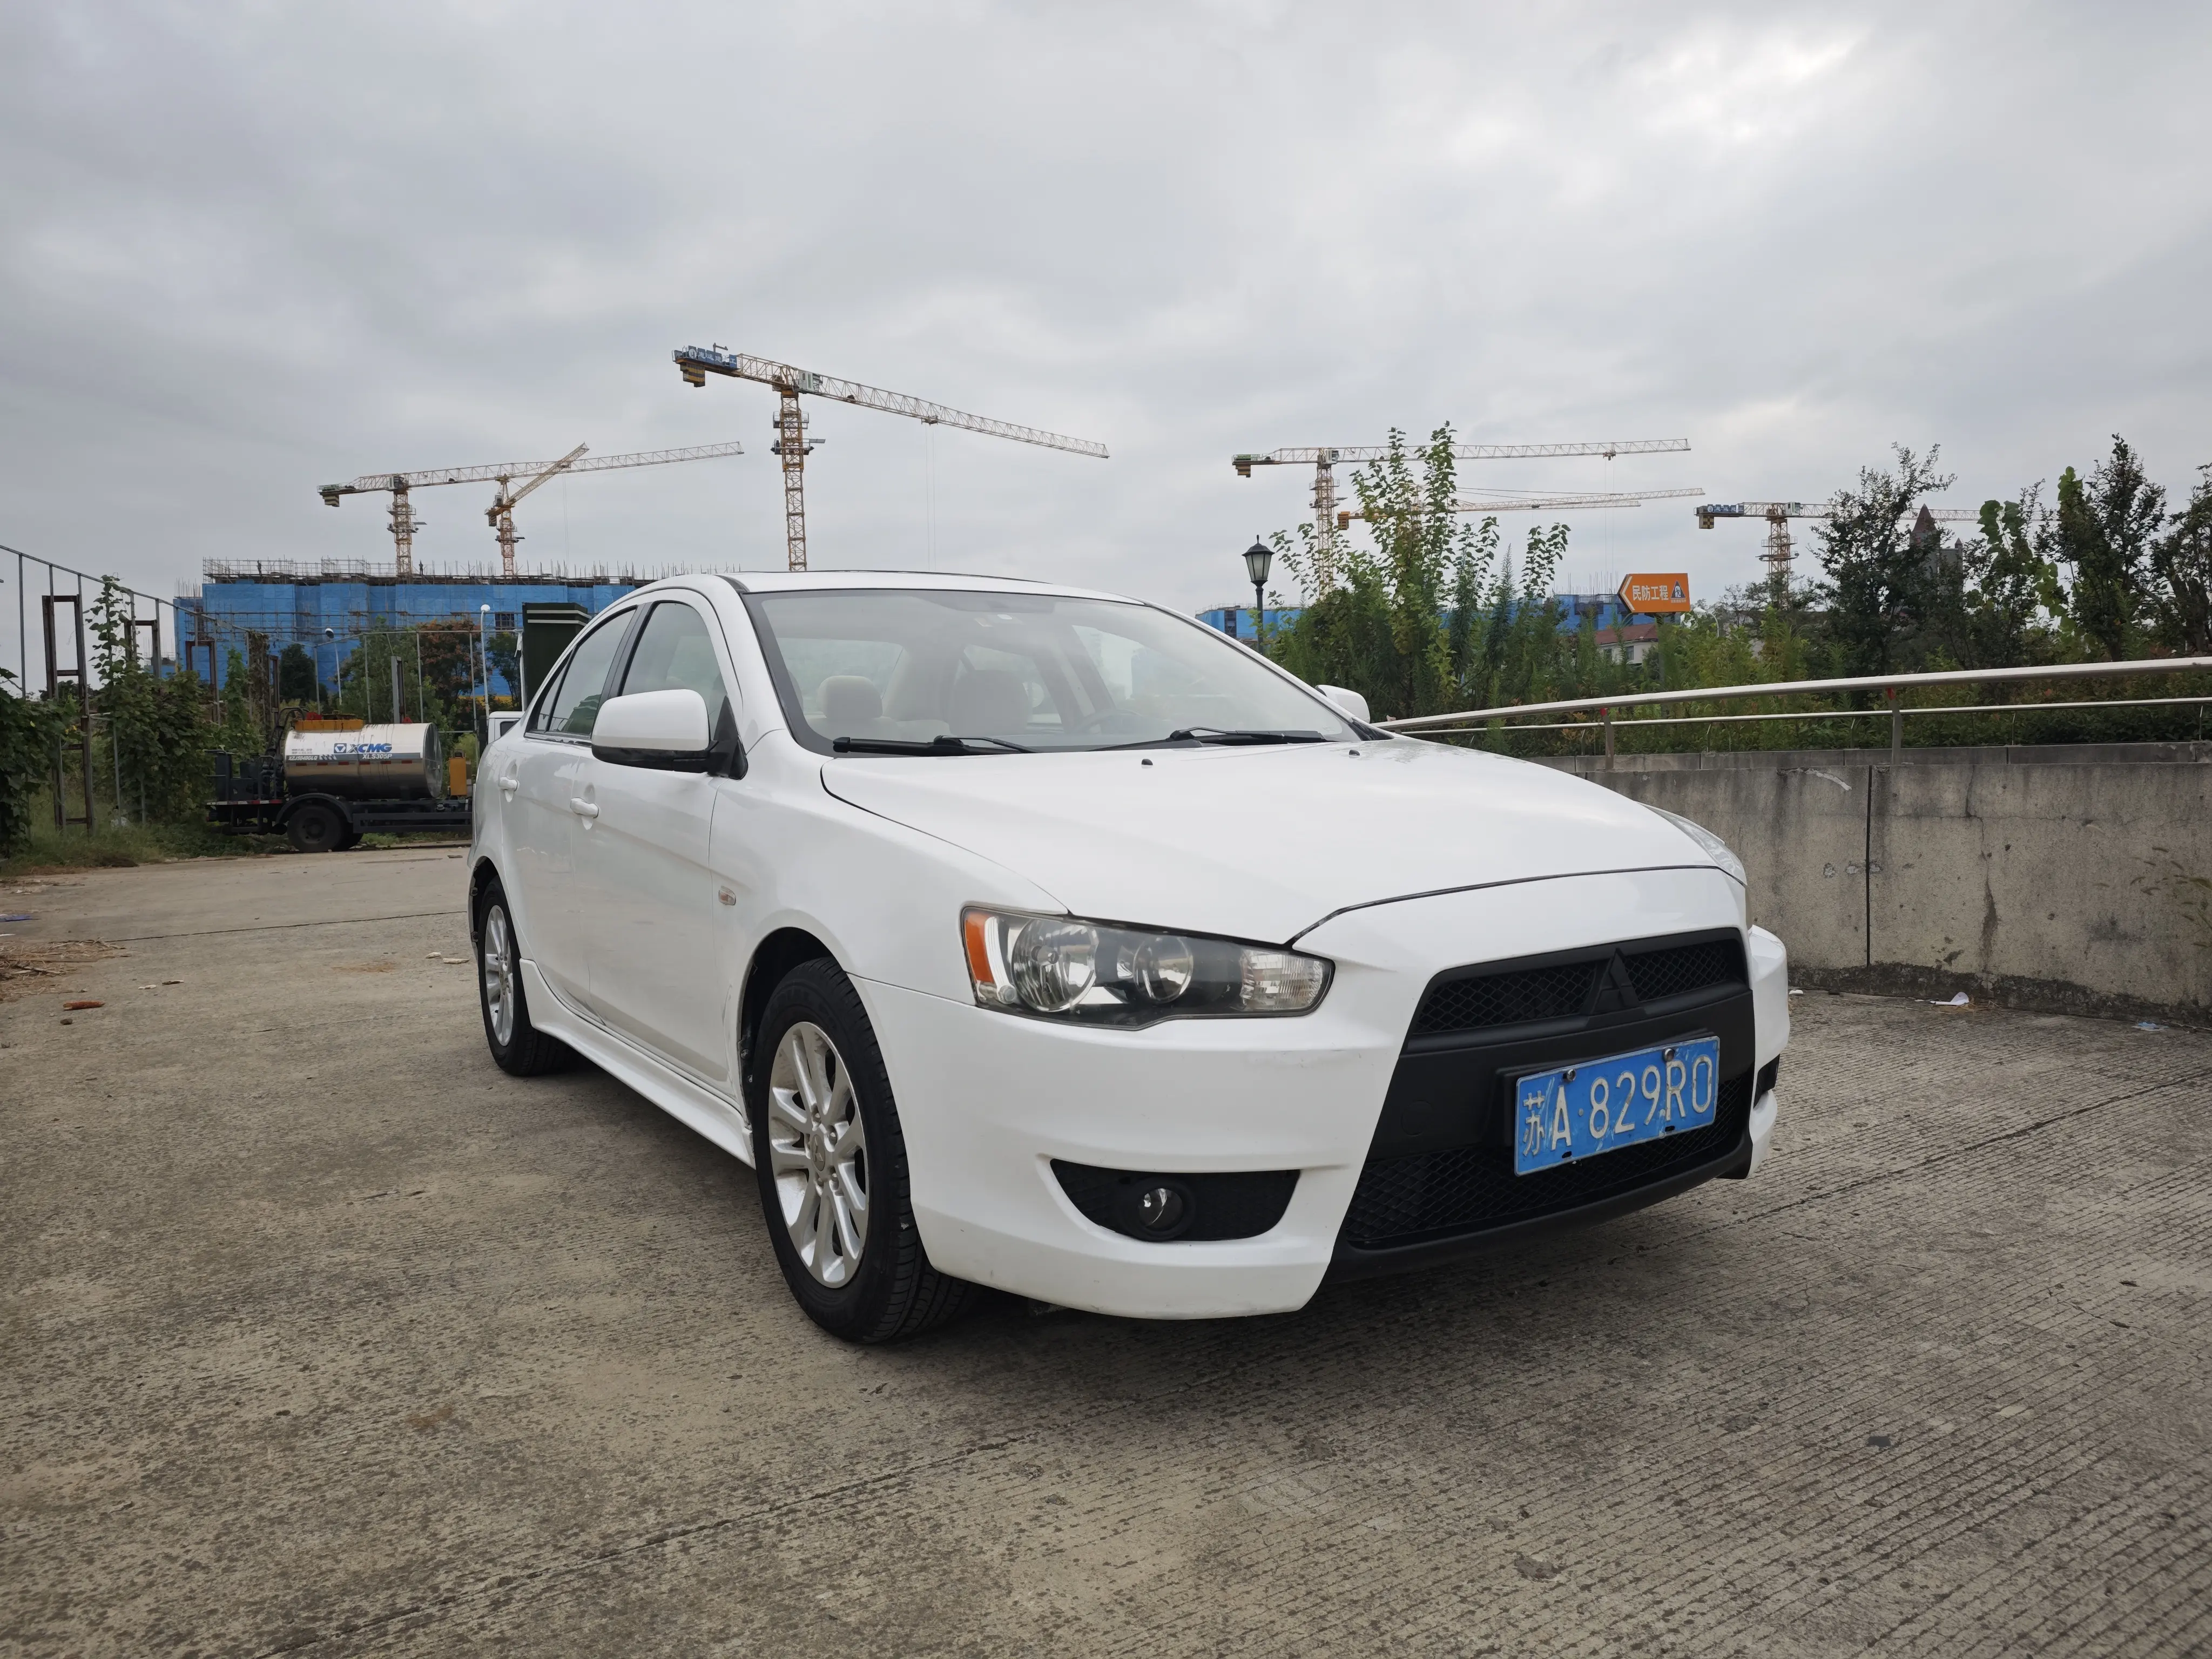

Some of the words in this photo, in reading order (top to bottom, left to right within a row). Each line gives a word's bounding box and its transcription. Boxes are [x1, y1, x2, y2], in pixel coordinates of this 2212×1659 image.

[1633, 585, 1669, 601] 民防工程
[347, 743, 392, 753] XCMG
